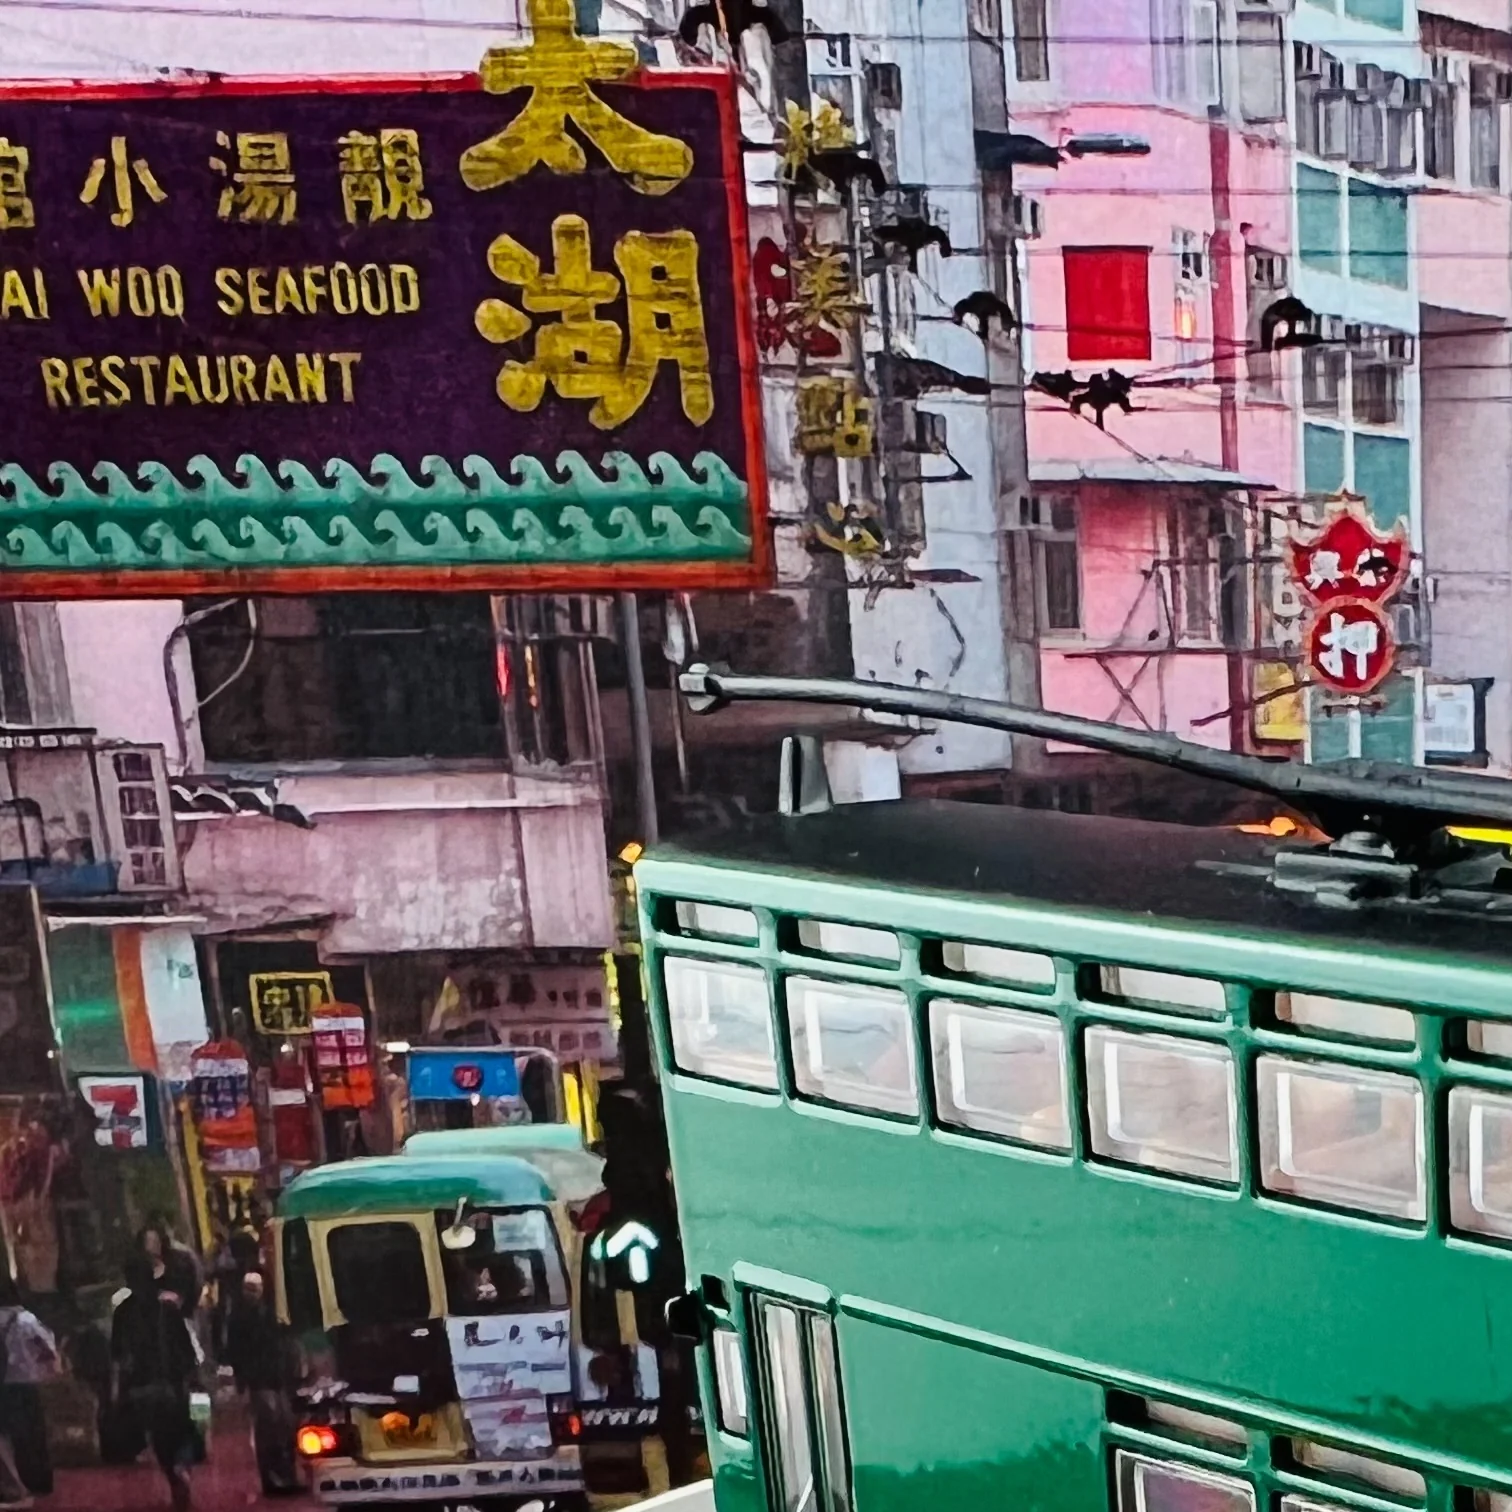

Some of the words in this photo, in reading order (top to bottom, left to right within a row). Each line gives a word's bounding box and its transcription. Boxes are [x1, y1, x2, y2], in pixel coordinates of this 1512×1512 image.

[77, 264, 187, 319] WOO
[215, 261, 421, 318] SEAFOOD
[40, 352, 362, 408] RESTAURANT
